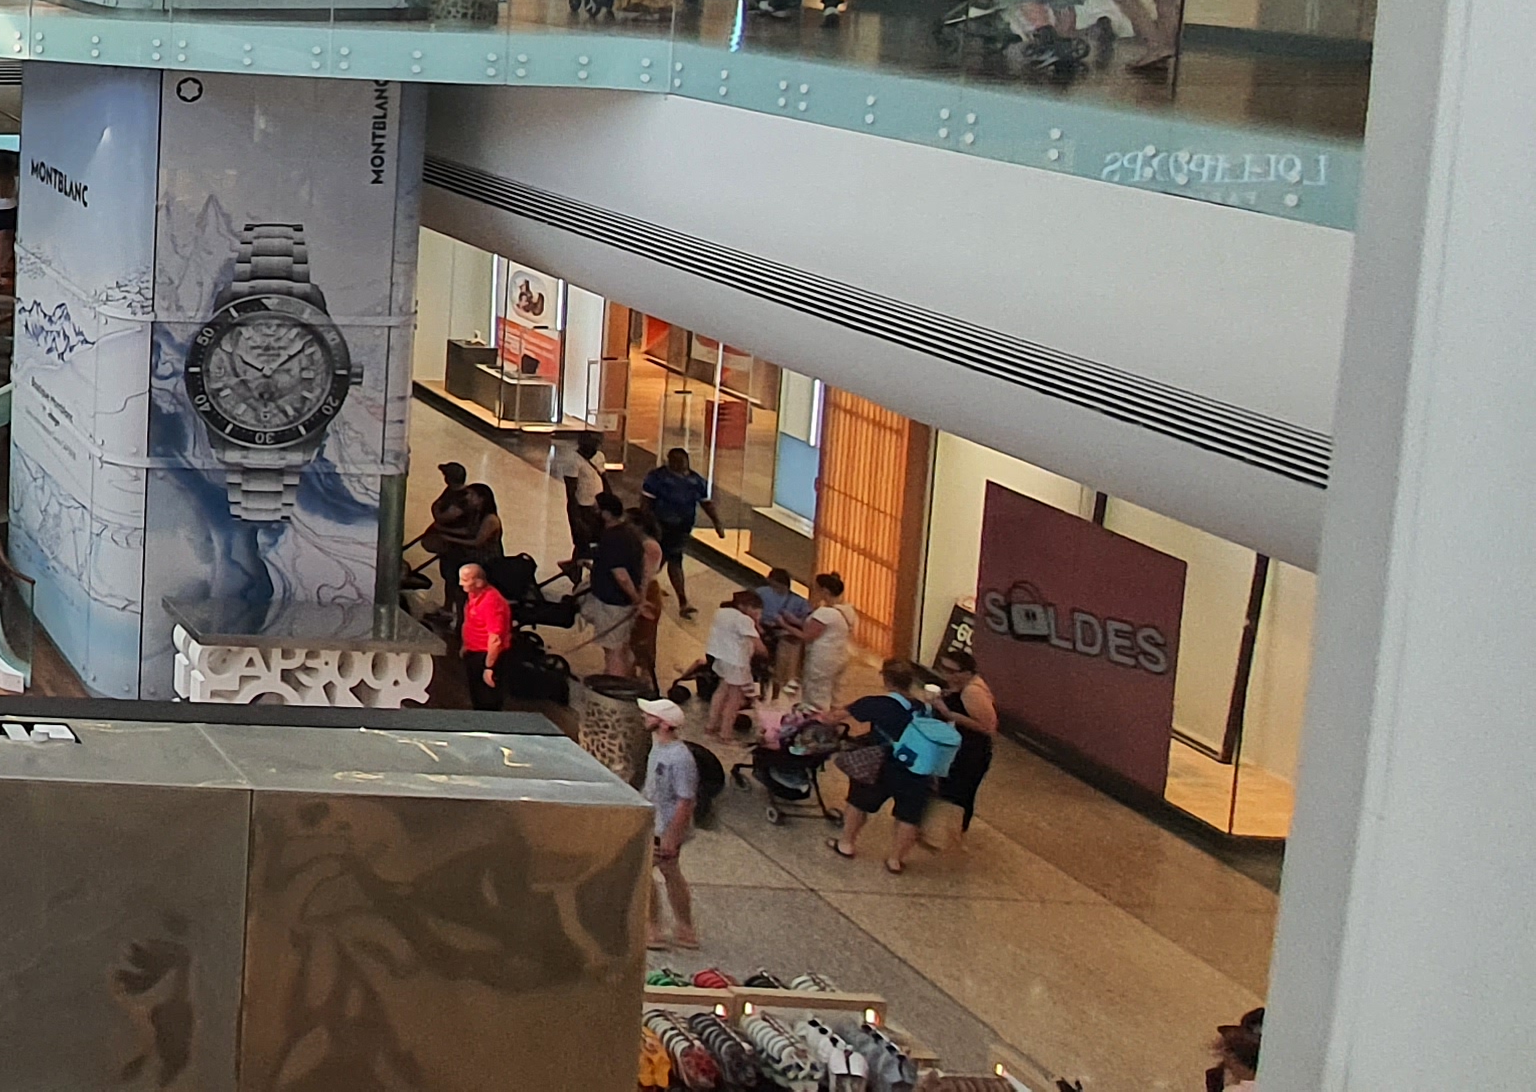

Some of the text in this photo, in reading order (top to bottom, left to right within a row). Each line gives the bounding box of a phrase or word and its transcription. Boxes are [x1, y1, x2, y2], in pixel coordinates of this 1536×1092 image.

[370, 79, 389, 185] MONTBLANC
[30, 157, 89, 208] MONTBLANC
[195, 326, 215, 348] 50
[194, 393, 212, 413] 40
[321, 394, 340, 416] 20
[254, 431, 276, 444] 30
